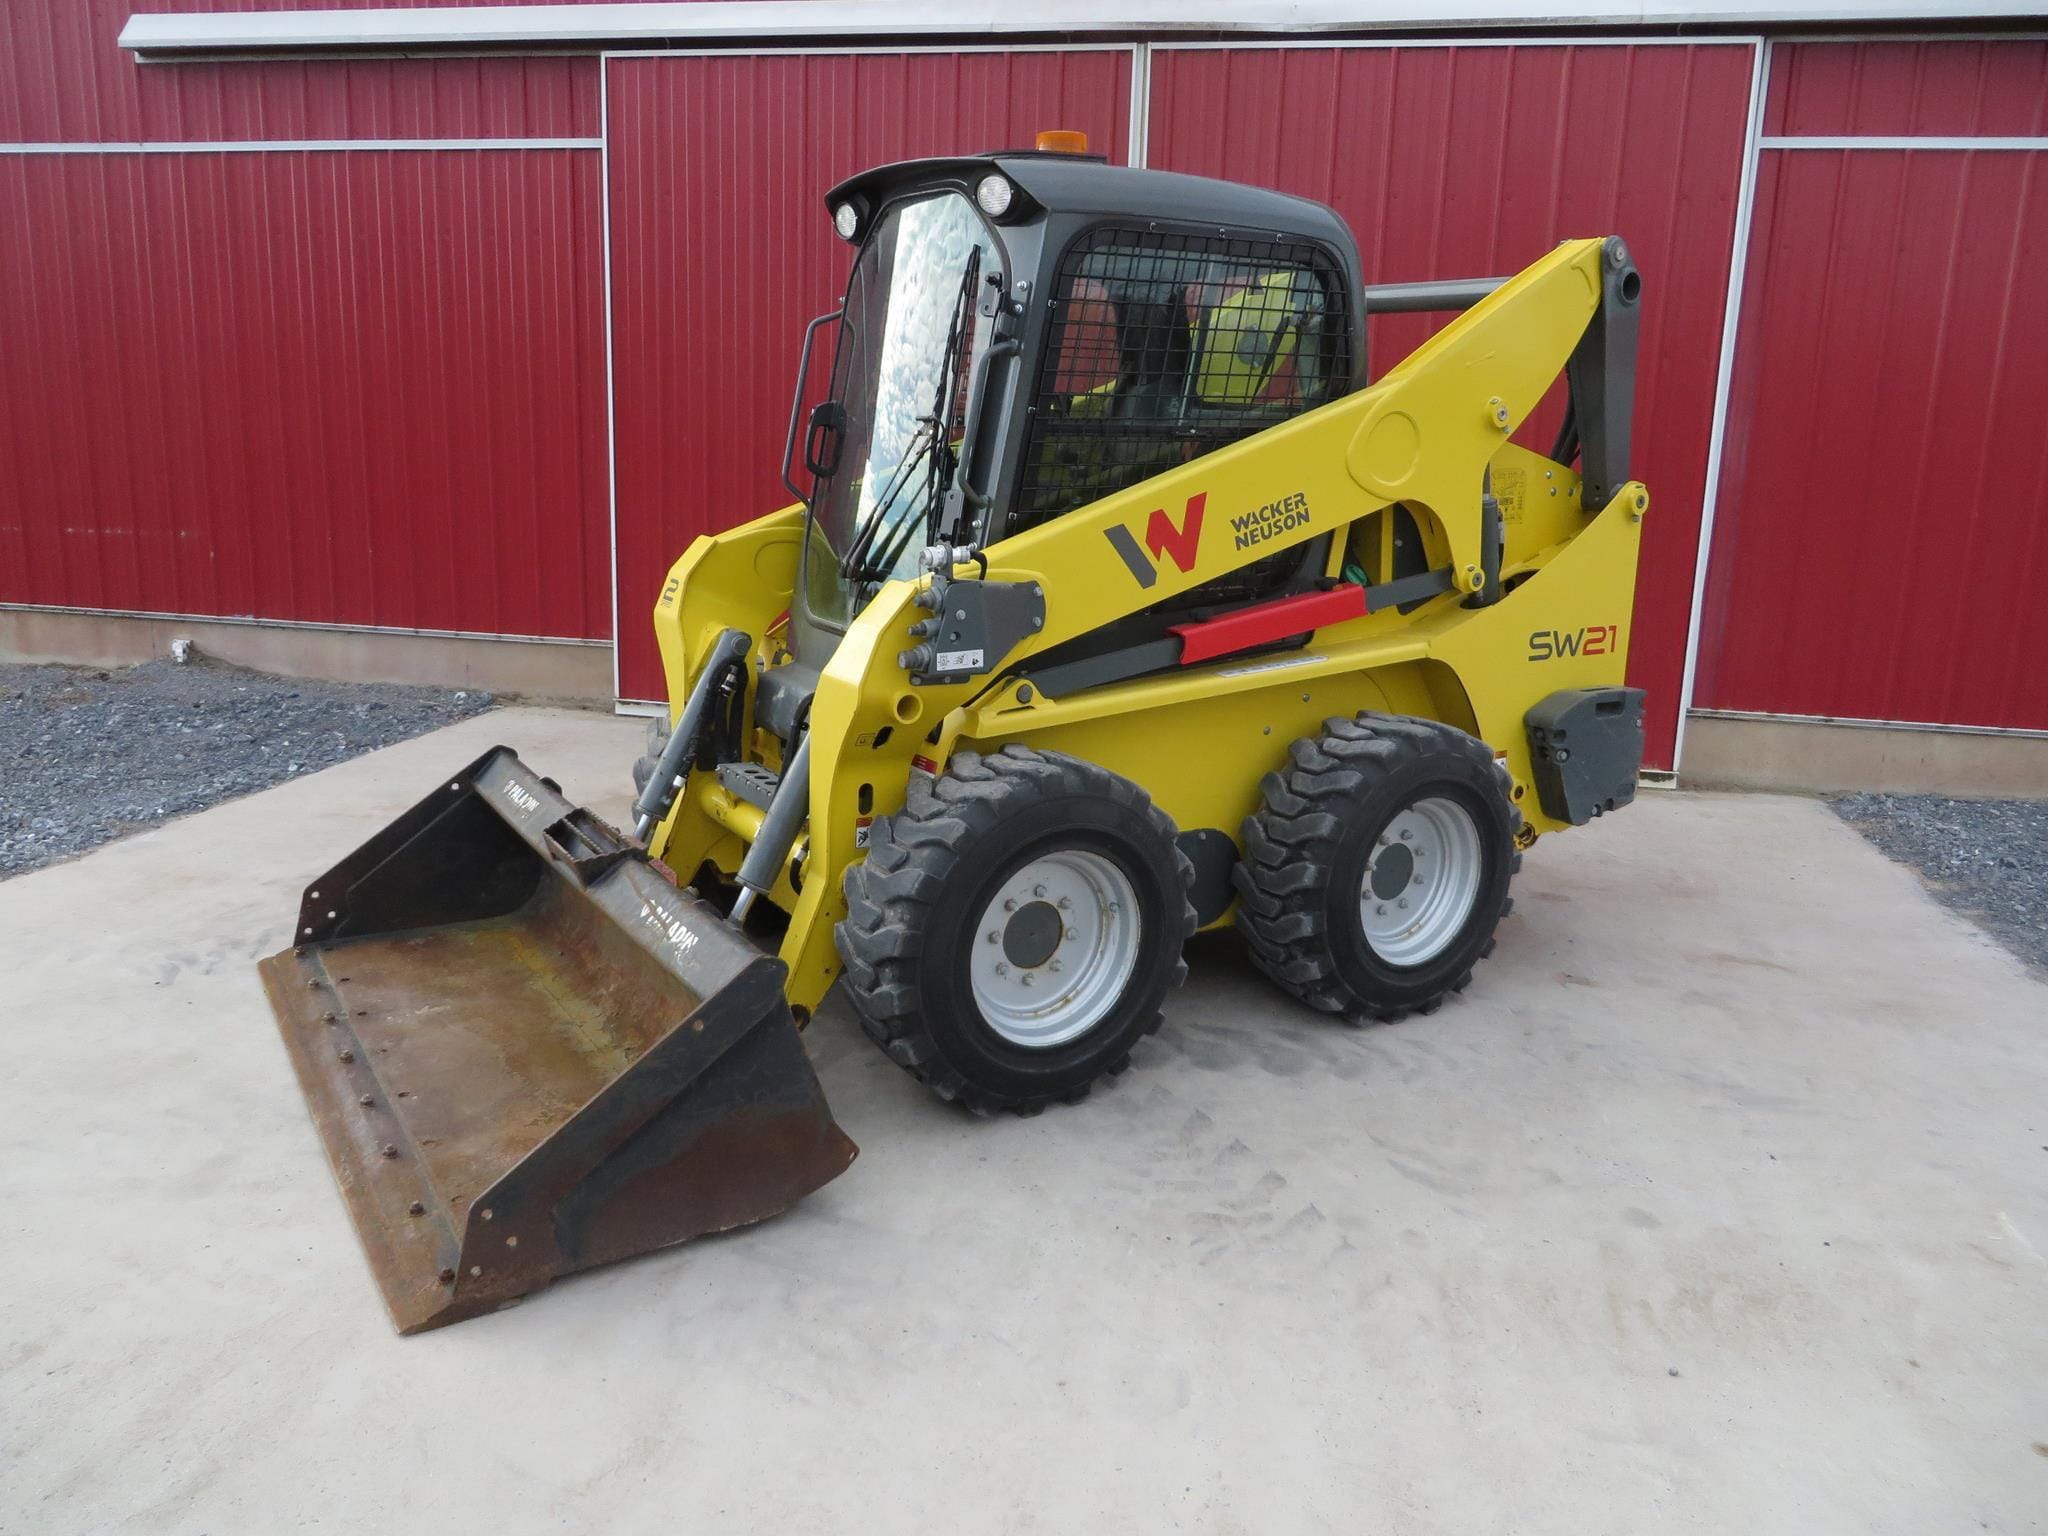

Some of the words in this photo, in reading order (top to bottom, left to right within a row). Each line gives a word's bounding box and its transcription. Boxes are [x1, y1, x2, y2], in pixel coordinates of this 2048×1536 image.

[1230, 492, 1308, 533] WACKER
[1234, 508, 1311, 551] NEUSON
[1528, 625, 1618, 662] SW21
